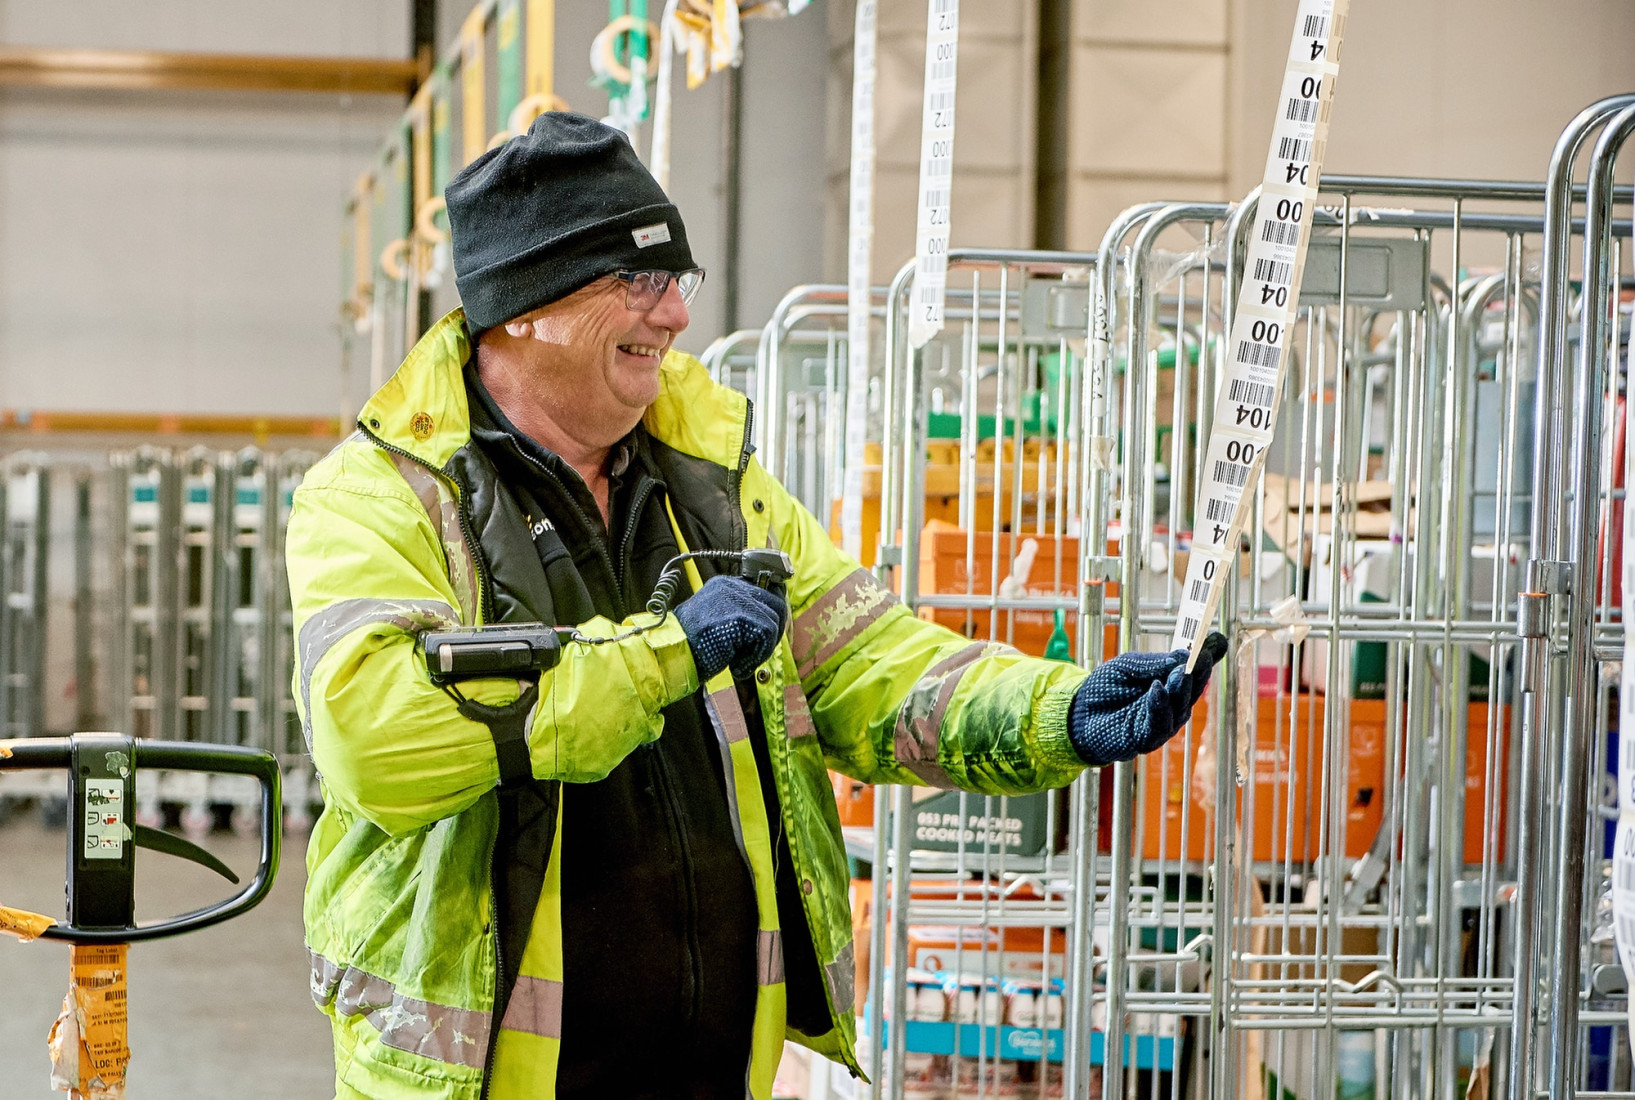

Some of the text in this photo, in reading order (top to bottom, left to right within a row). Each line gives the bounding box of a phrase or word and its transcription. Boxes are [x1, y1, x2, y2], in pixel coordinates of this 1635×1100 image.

[1310, 40, 1326, 61] 4
[1276, 199, 1303, 223] 00
[1261, 284, 1287, 307] 04
[1251, 320, 1284, 345] 00
[1236, 405, 1271, 431] 104
[1226, 440, 1264, 465] 00
[531, 517, 556, 541] on
[1213, 524, 1229, 545] 4
[1204, 560, 1218, 581] 0
[942, 813, 966, 828] PR
